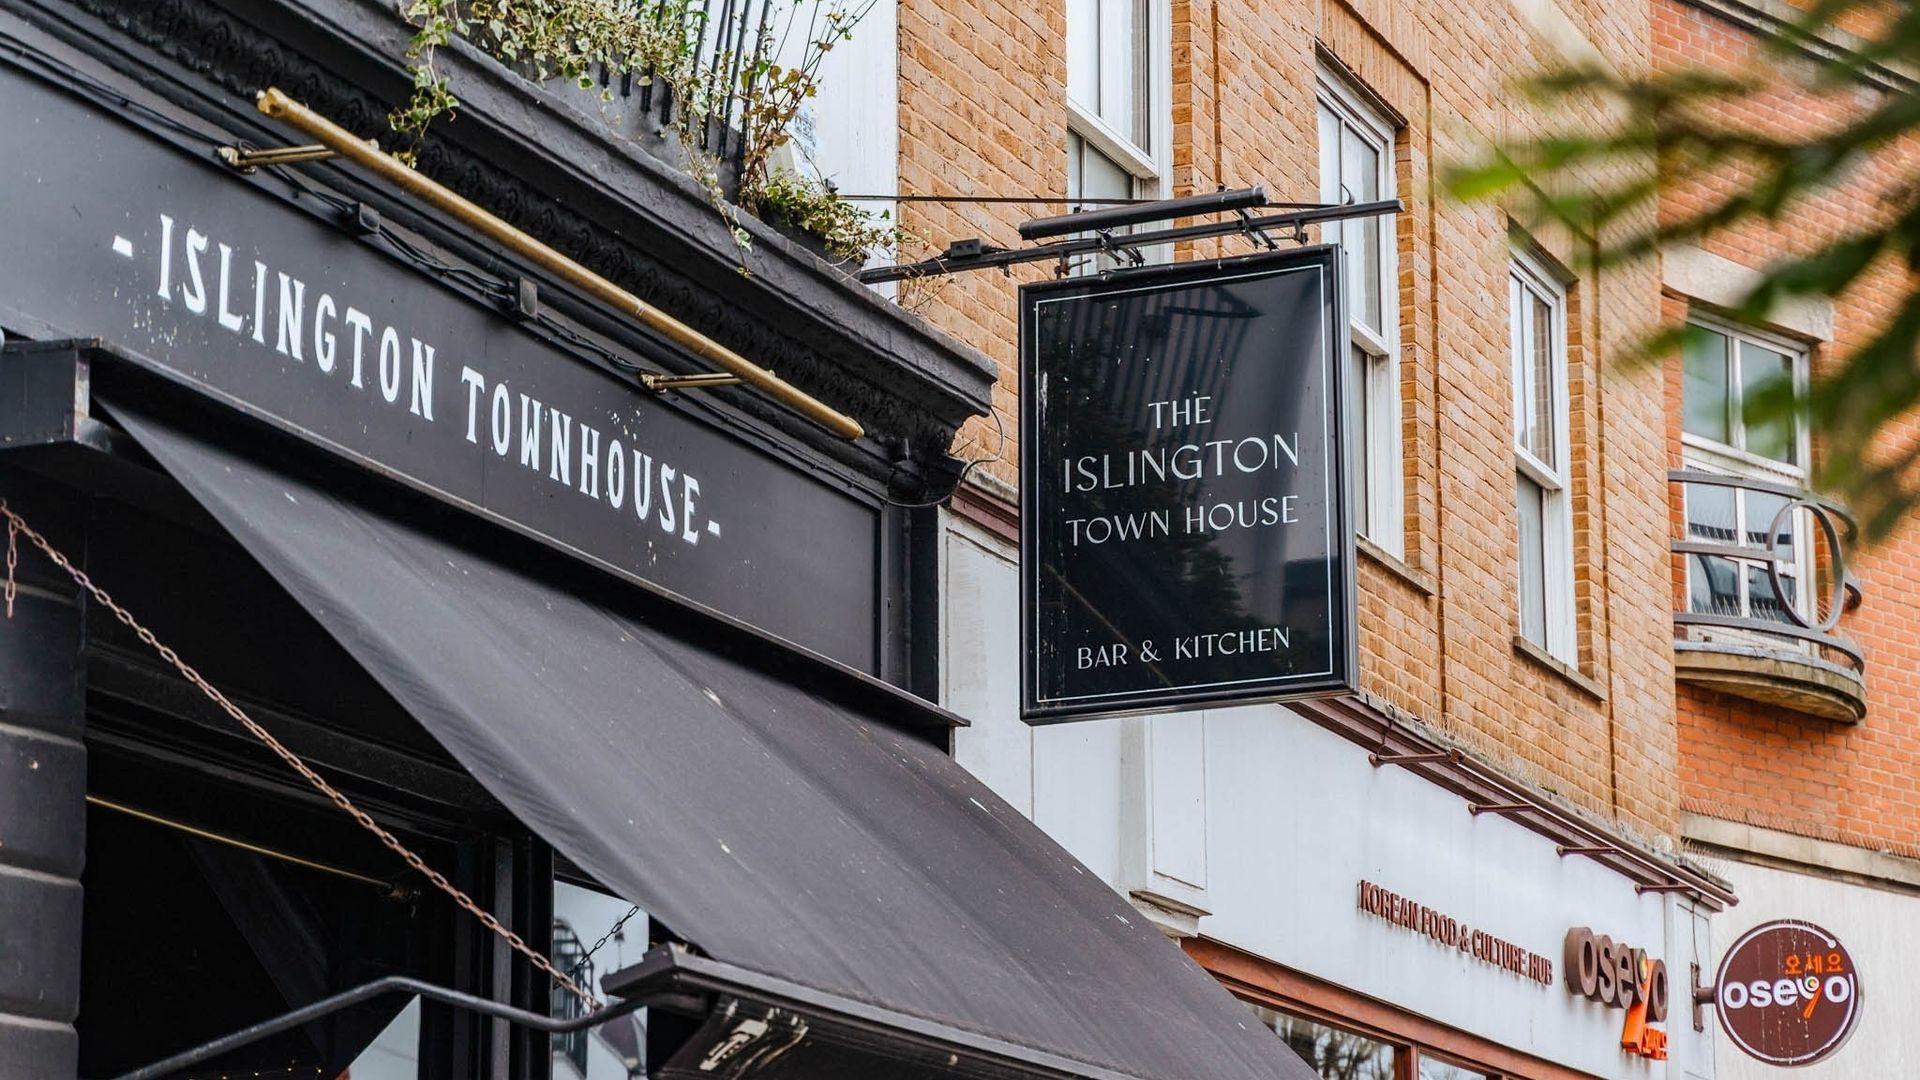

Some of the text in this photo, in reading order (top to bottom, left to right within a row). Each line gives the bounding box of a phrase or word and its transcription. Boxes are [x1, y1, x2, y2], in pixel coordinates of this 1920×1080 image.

[158, 213, 702, 546] ISLINGTON TOWNHOUSE
[1147, 394, 1212, 430] THE
[1064, 432, 1299, 493] ISLINGTON
[1064, 494, 1300, 547] TOWN HOUSE
[1076, 625, 1291, 671] BAR & KITCHEN
[1358, 880, 1554, 986] KOREAN FOOD & CULTURE HUB
[1784, 951, 1845, 977] 오세요
[1723, 974, 1850, 1019] oseyo
